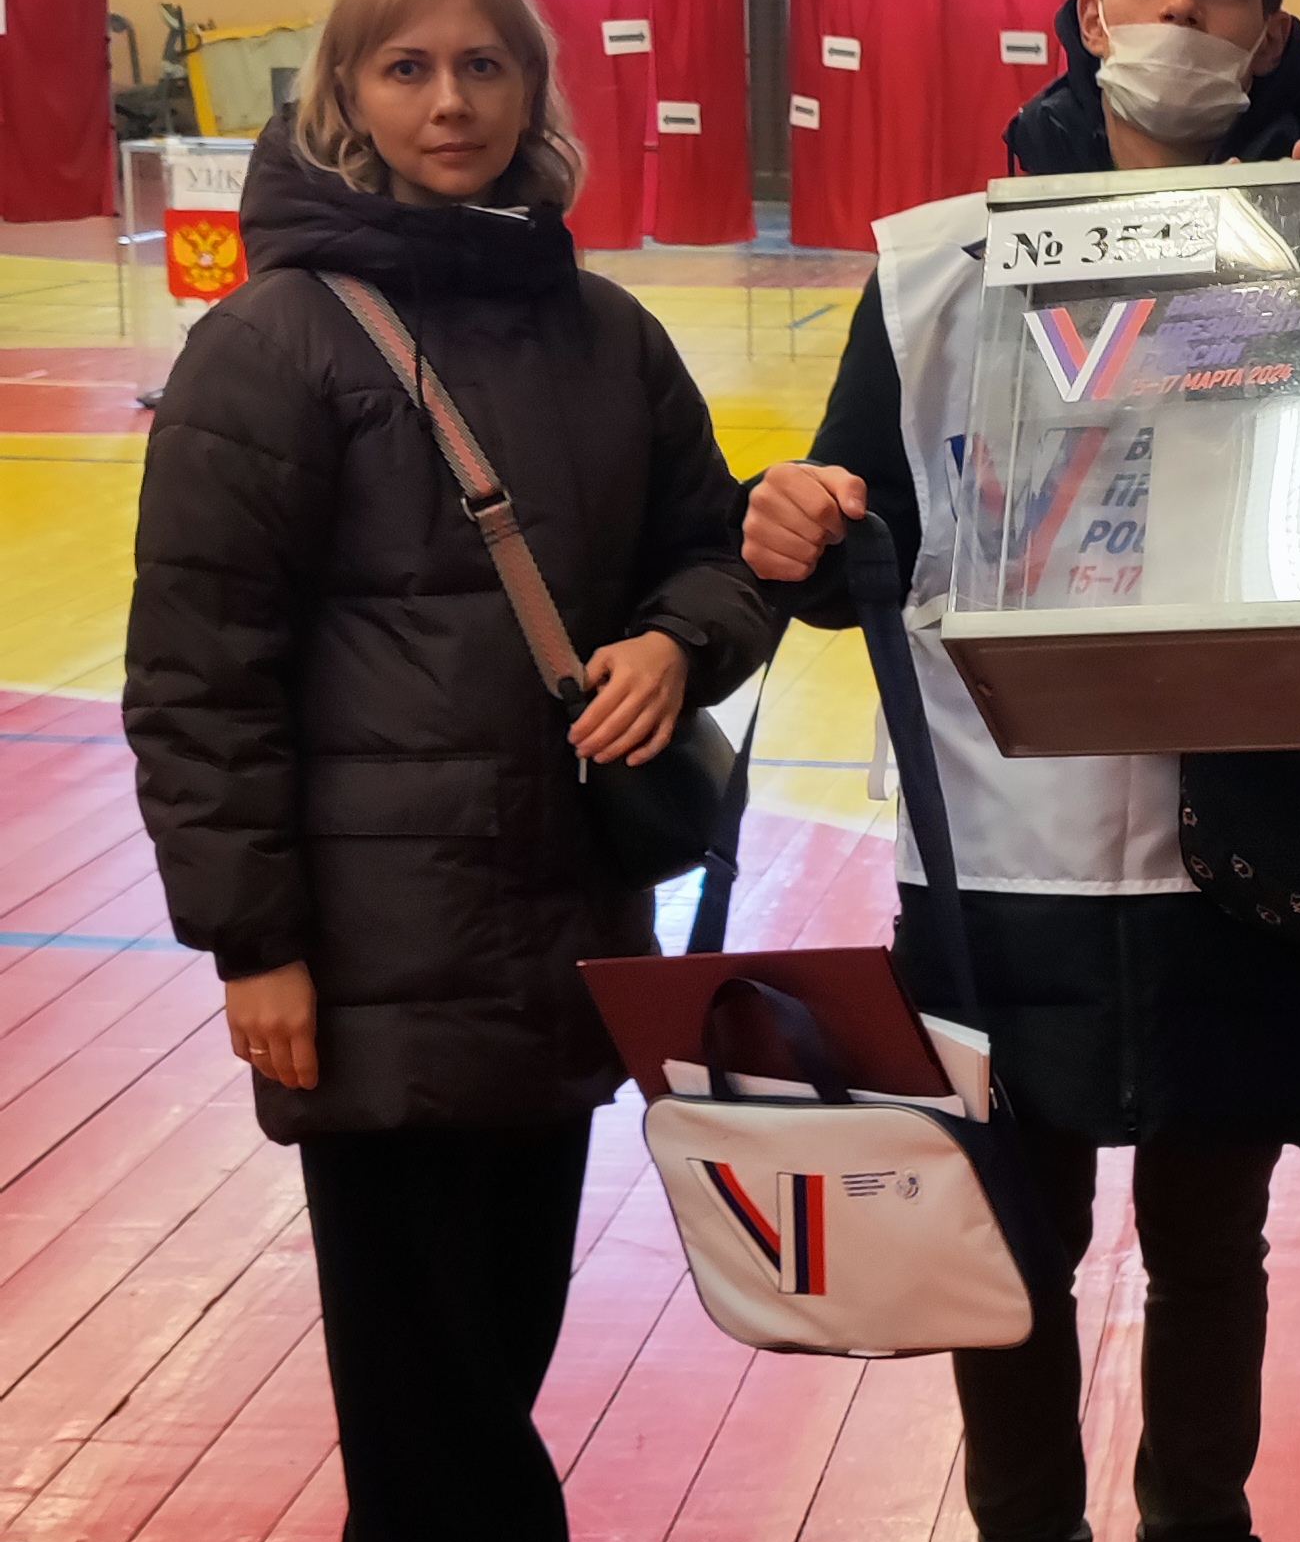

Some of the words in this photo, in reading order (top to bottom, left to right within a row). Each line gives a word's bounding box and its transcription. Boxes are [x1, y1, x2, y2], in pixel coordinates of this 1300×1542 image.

[1003, 230, 1063, 269] №
[1140, 342, 1246, 372] РСИИ
[1181, 368, 1244, 391] МАРТА
[1247, 363, 1293, 385] 2024
